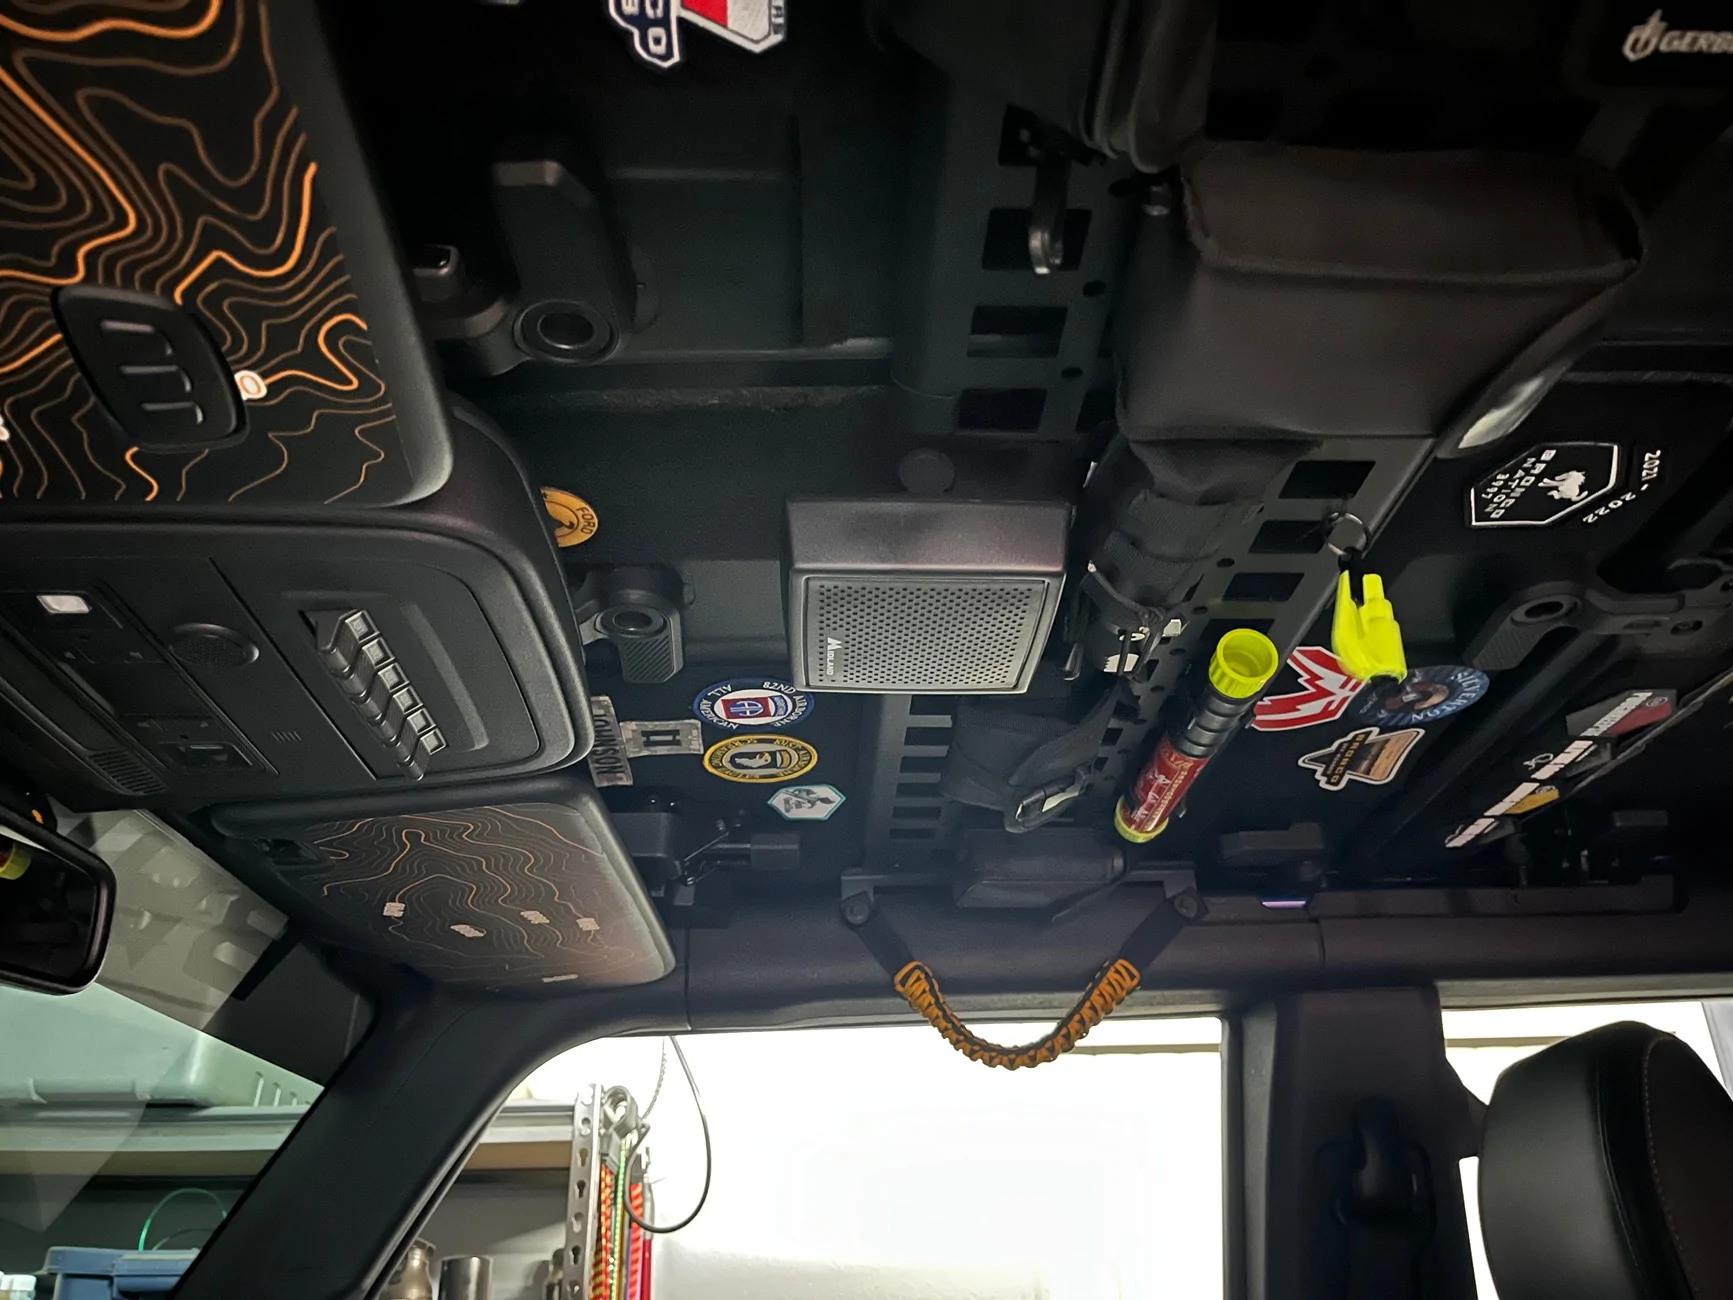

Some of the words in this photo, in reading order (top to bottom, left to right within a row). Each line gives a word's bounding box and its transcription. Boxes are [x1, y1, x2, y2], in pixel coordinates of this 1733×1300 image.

[1642, 450, 1661, 481] 2021
[1484, 457, 1536, 513] NATION
[1490, 449, 1557, 518] BRONCO
[576, 507, 596, 534] FORD
[1582, 492, 1636, 523] 2022
[827, 637, 842, 675] MIDLAND
[708, 684, 732, 697] ALL
[763, 681, 796, 694] 82ND
[1411, 672, 1480, 722] SILVERTON
[700, 698, 739, 729] AMERICAN
[771, 695, 808, 727] AIRBORNE
[592, 714, 626, 775] JOHNSON
[1330, 734, 1366, 783] BRONCO
